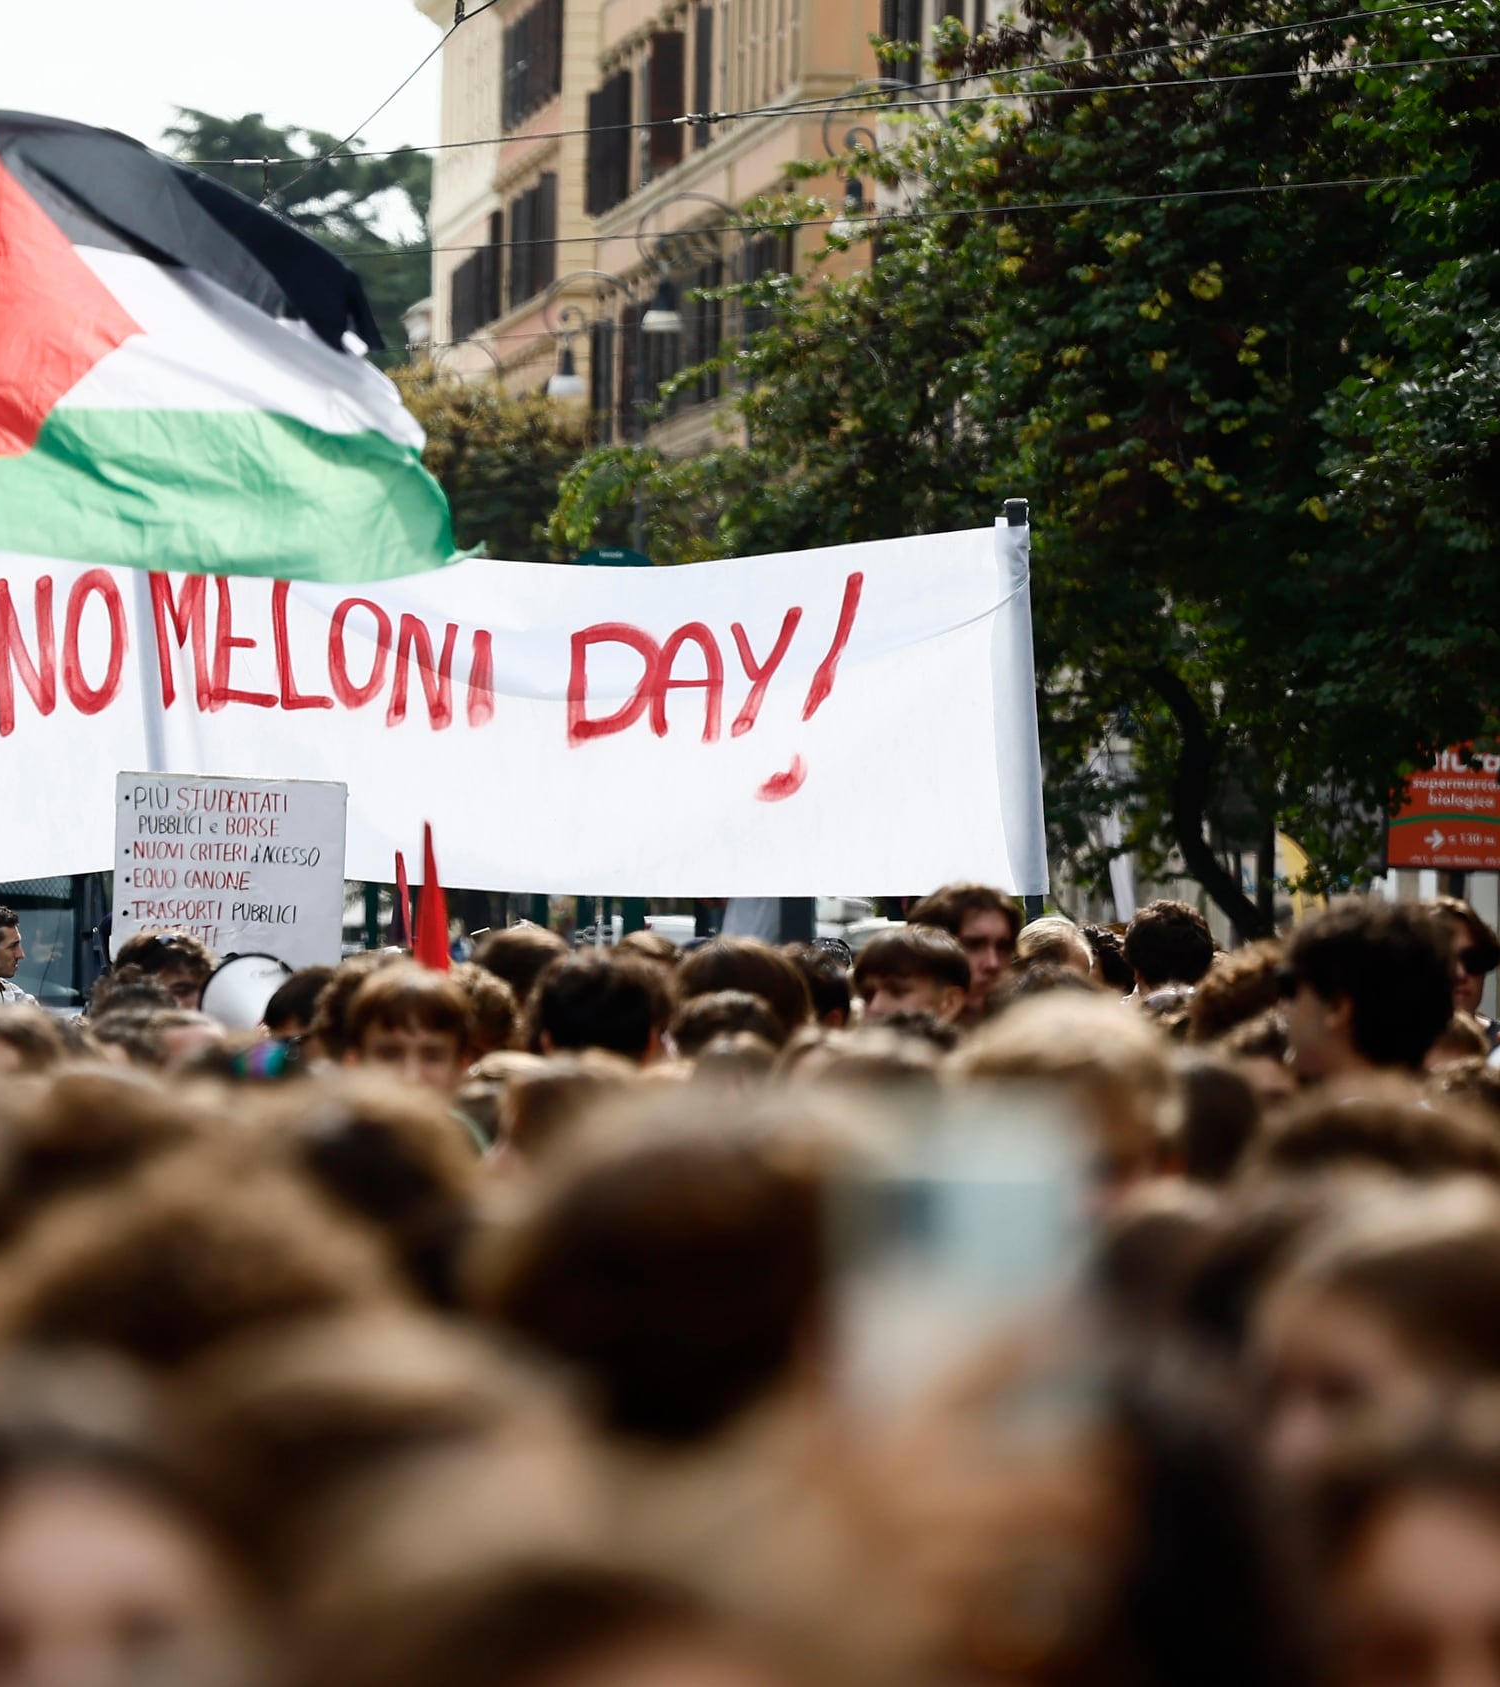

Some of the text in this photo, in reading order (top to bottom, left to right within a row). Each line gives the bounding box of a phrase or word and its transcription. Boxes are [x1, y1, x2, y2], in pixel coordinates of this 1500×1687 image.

[148, 571, 496, 733] MELONI
[133, 781, 288, 814] PIÙ STUDENTATI
[138, 814, 202, 835] PUBBLICI
[225, 816, 281, 838] BORSE
[133, 840, 184, 862] NUOVI
[189, 842, 248, 863] CRITERI
[133, 867, 252, 891] EQUO CANONE
[131, 900, 297, 924] TRASPORTI PUBBLICI
